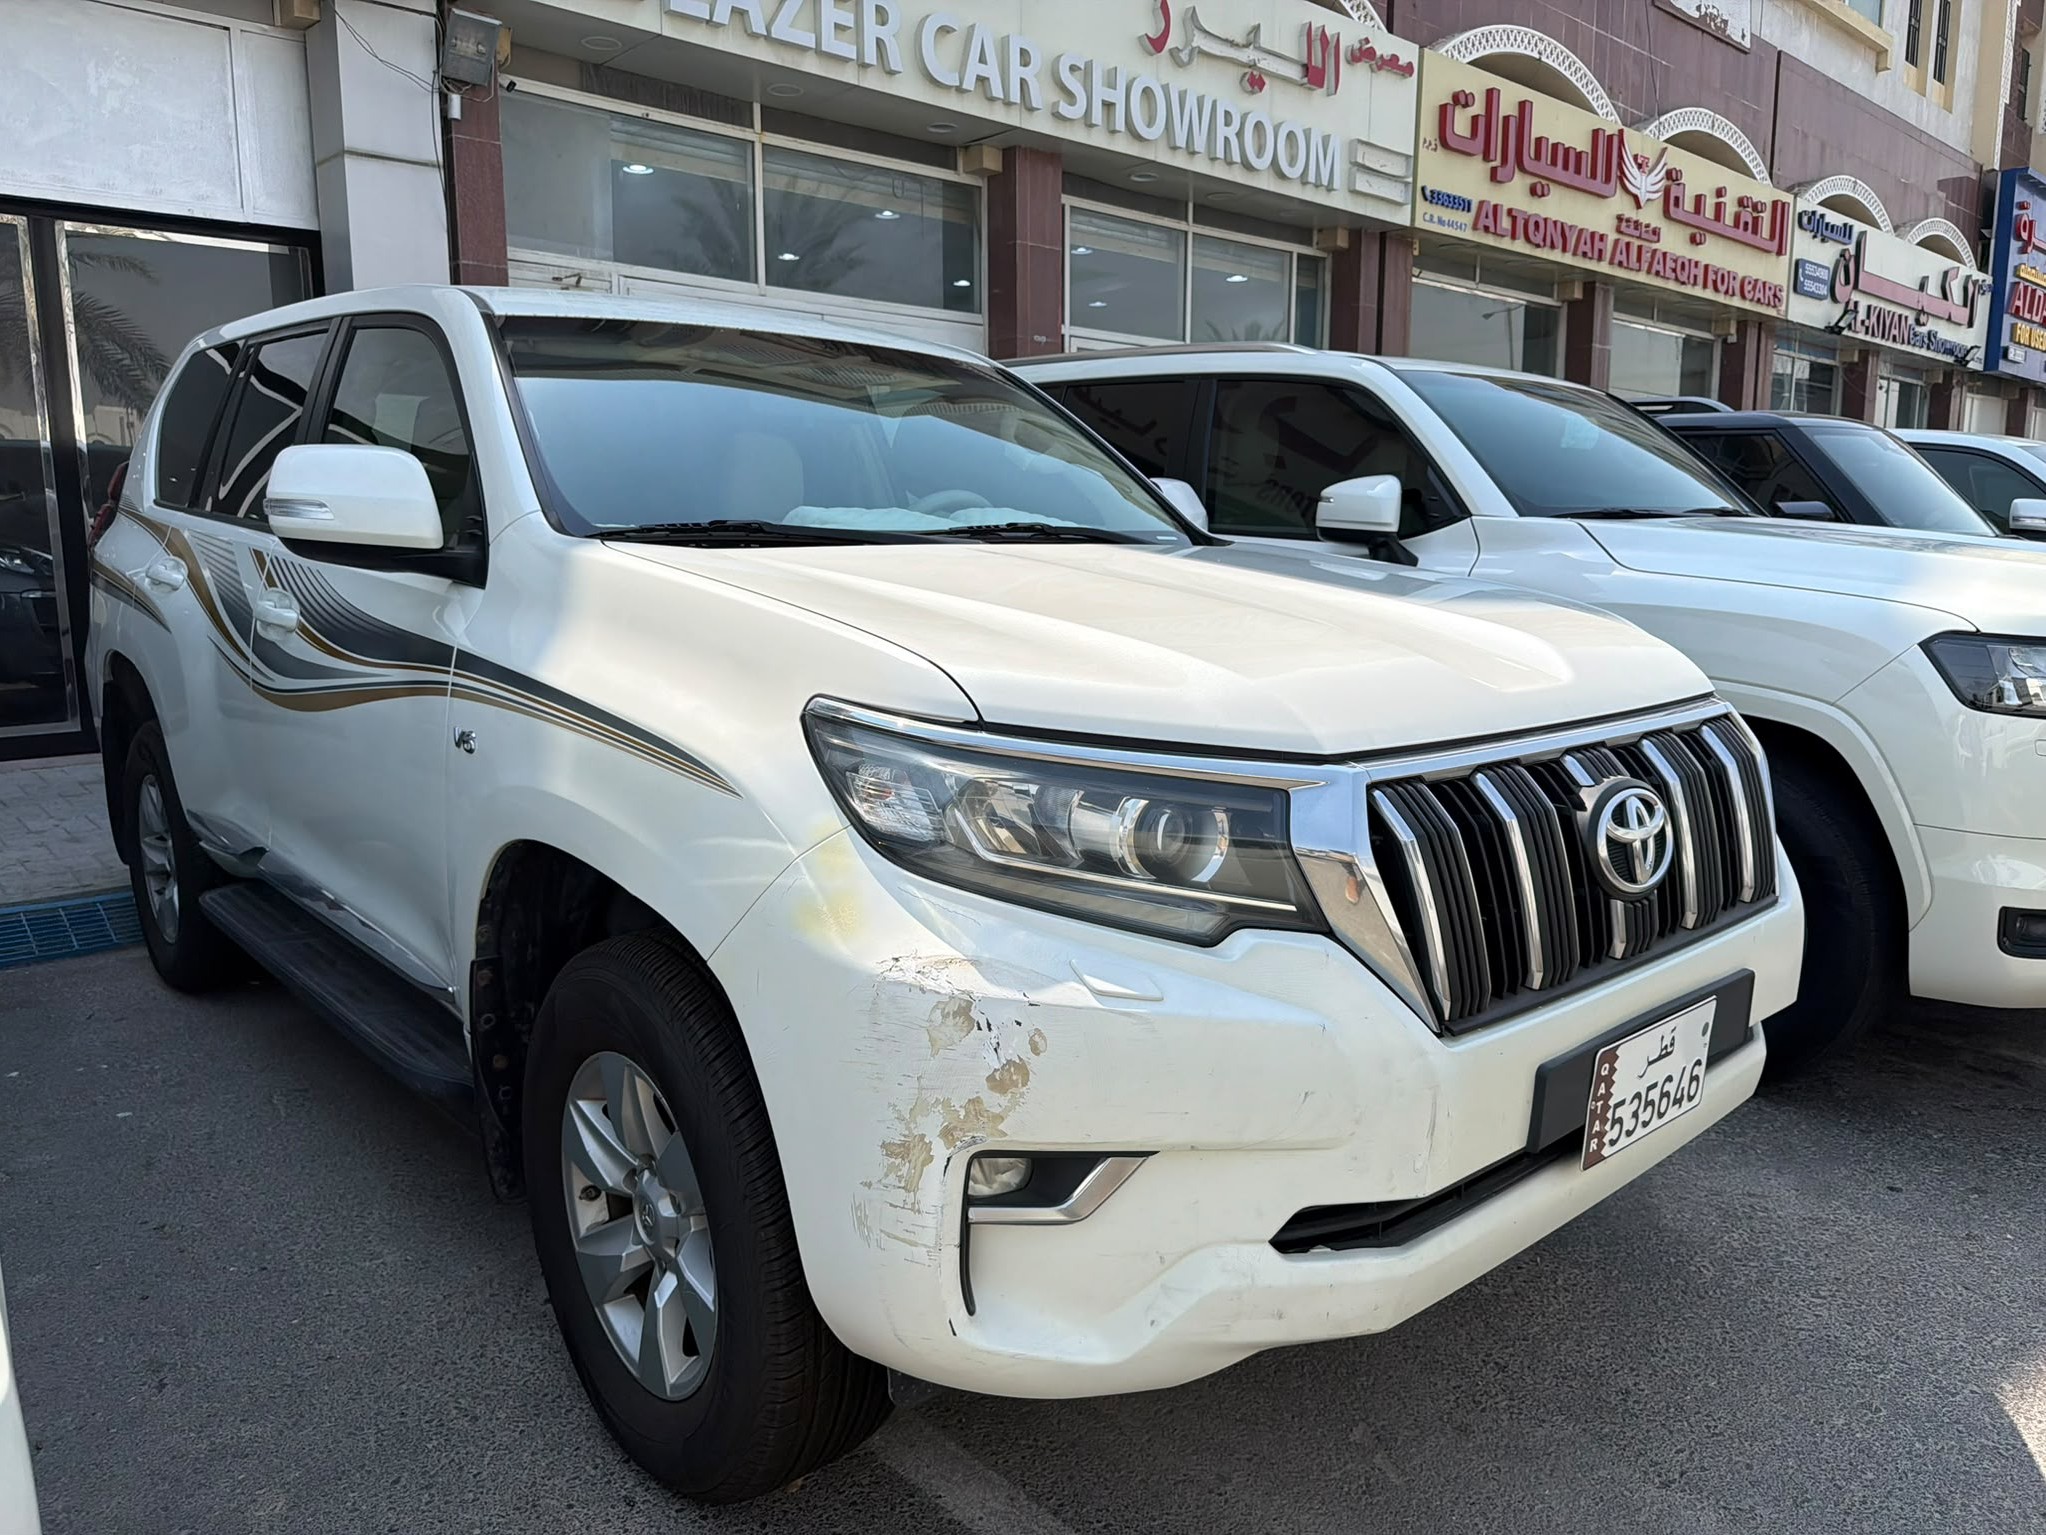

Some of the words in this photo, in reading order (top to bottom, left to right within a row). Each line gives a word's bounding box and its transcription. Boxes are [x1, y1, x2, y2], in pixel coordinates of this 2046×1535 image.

[915, 12, 1043, 111] CAR
[1051, 52, 1341, 192] SHOWROOM
[1438, 87, 1621, 199] للسيارات
[1472, 199, 1609, 263] ALTQNYAH
[1608, 237, 1701, 290] ALFAEQH
[1703, 262, 1739, 299] FOR
[1739, 274, 1785, 309] CARS
[1662, 167, 1790, 257] التقنية
[1638, 1025, 1678, 1079] قطر
[1588, 1062, 1610, 1152] QATAR
[1607, 1057, 1703, 1148] 535646
